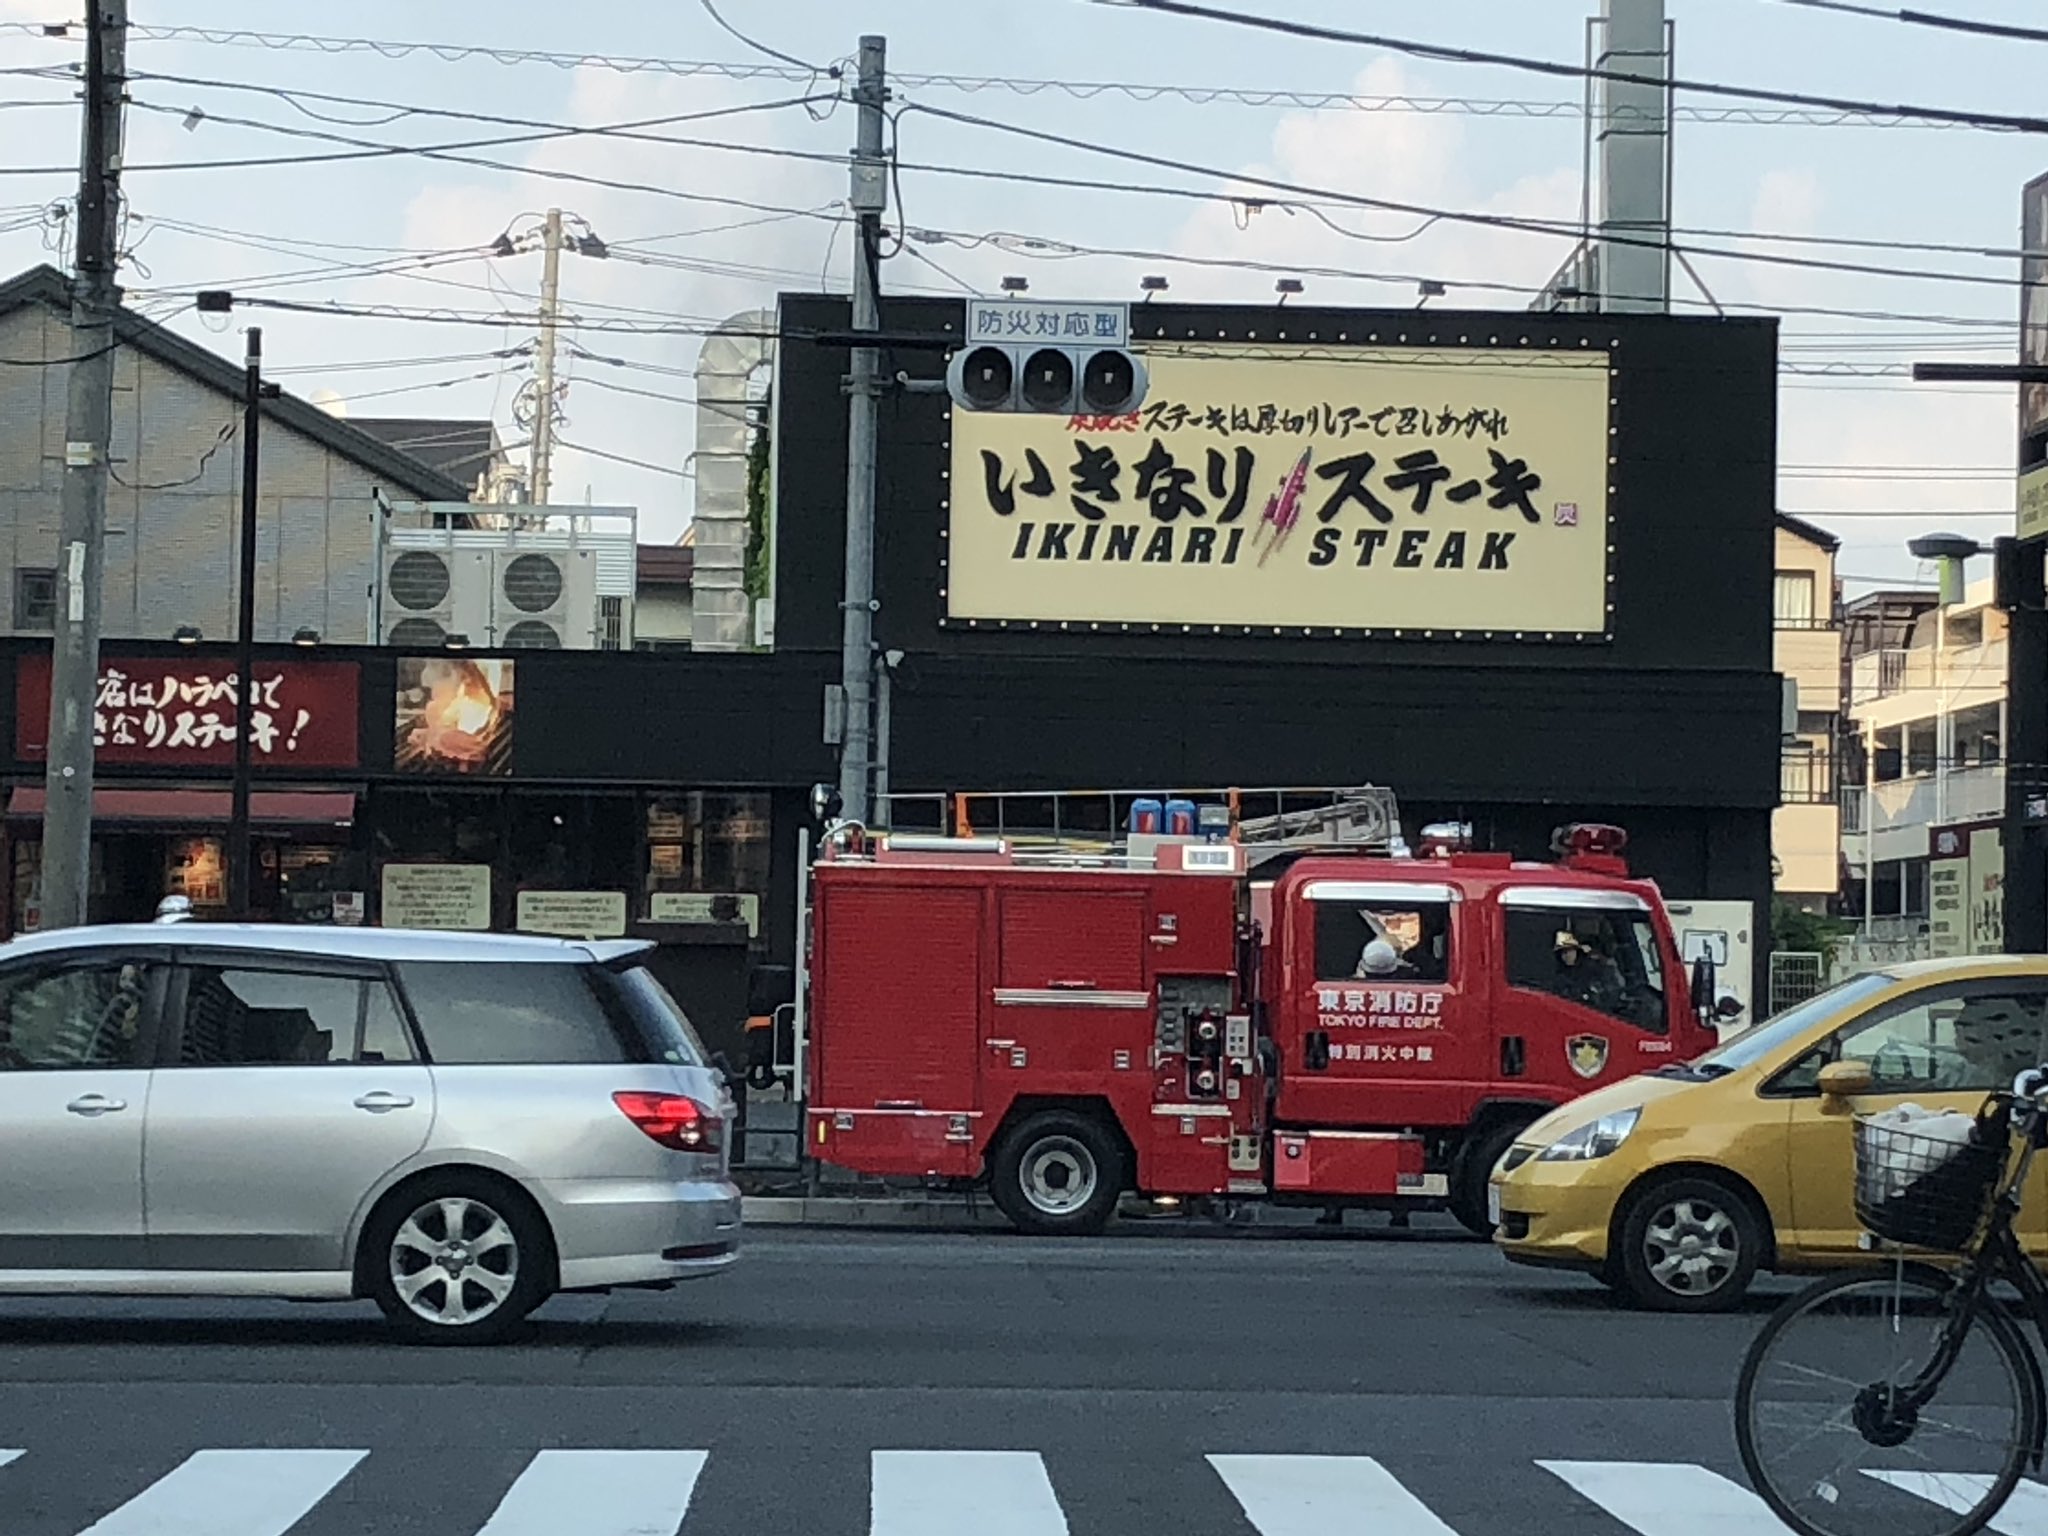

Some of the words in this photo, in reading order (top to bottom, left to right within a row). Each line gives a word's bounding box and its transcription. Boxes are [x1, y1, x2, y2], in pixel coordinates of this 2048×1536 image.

[977, 309, 1118, 338] 防災対応型
[981, 440, 1255, 524] いきなり
[1315, 447, 1542, 524] ステーキ
[1012, 523, 1246, 565] IKINARI
[1309, 528, 1516, 571] STEAK
[1318, 990, 1443, 1014] 東京消防庁
[1318, 1014, 1367, 1028] TOKYO
[1368, 1016, 1401, 1029] FIRE
